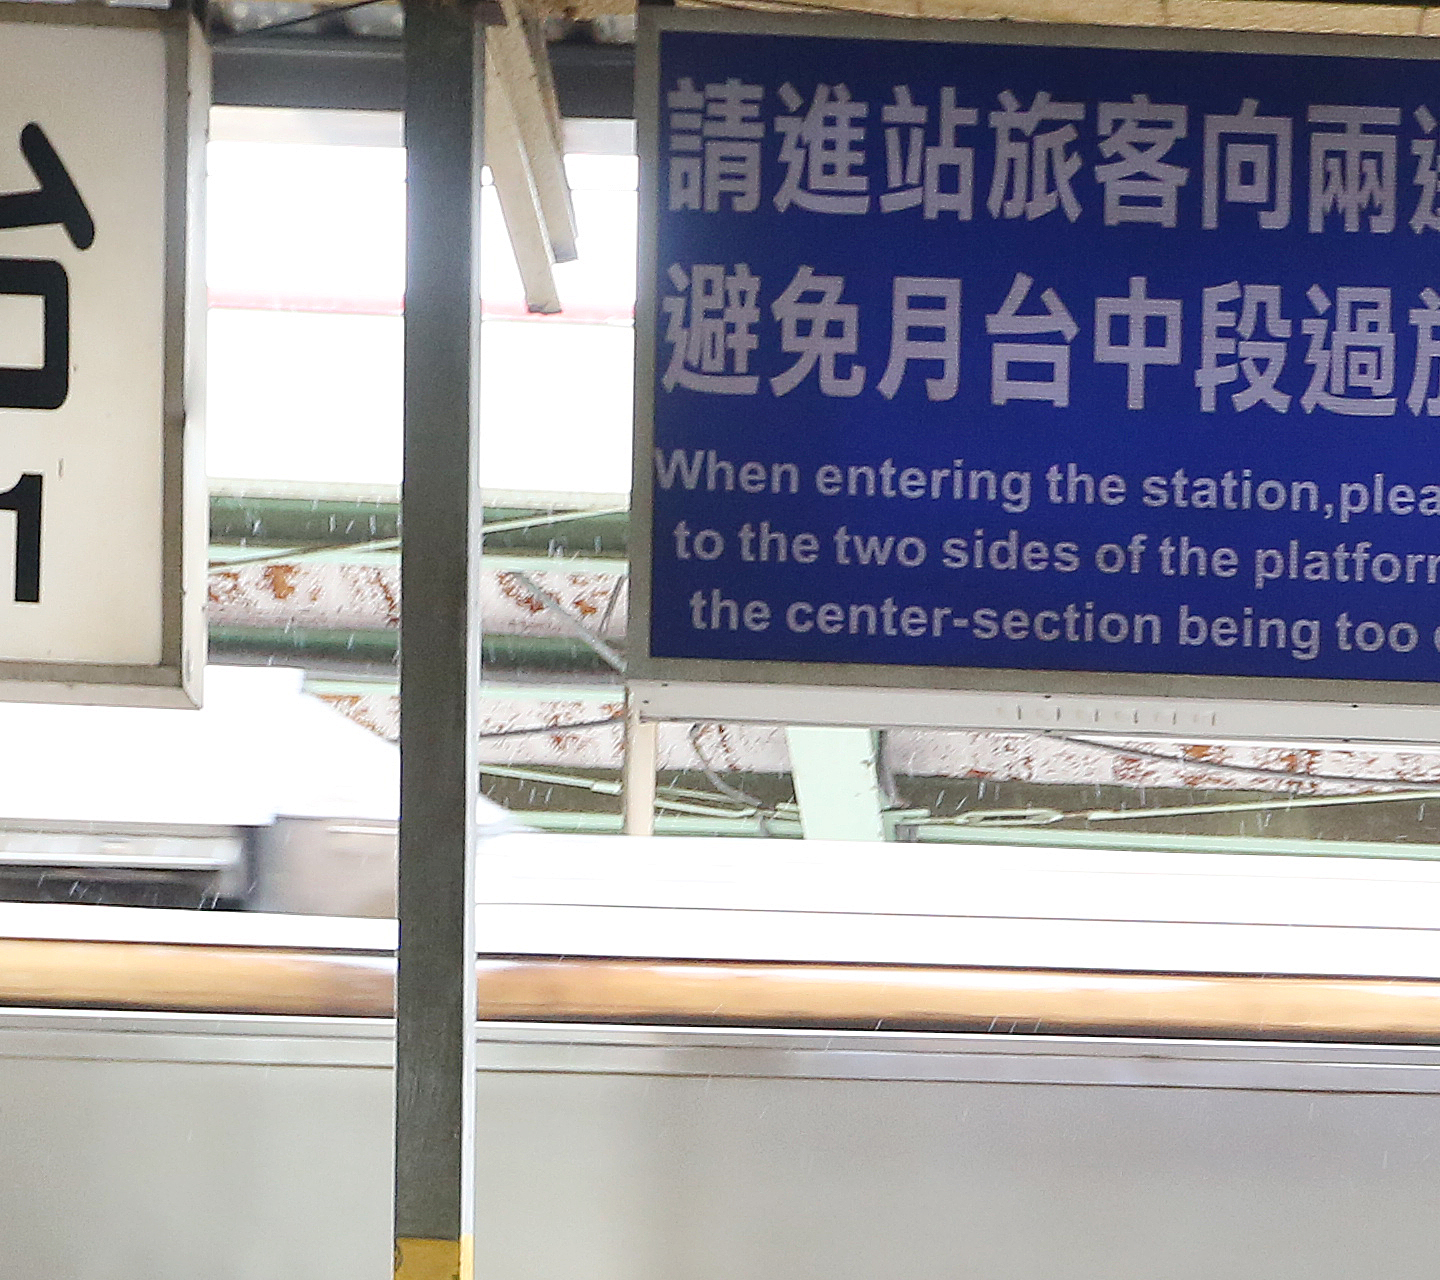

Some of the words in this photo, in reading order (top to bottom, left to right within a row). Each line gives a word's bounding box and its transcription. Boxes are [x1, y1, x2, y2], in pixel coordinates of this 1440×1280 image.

[655, 447, 799, 494] When
[816, 457, 1031, 513] entering
[1046, 463, 1127, 505] the
[674, 521, 724, 560] to
[738, 522, 820, 564] the
[833, 526, 927, 567] two
[942, 530, 1080, 573] sides
[1095, 534, 1149, 574] of
[1159, 537, 1239, 578] the
[689, 591, 771, 632] the
[786, 598, 1162, 645] center-section
[1178, 604, 1321, 660] being
[1334, 613, 1419, 653] too
